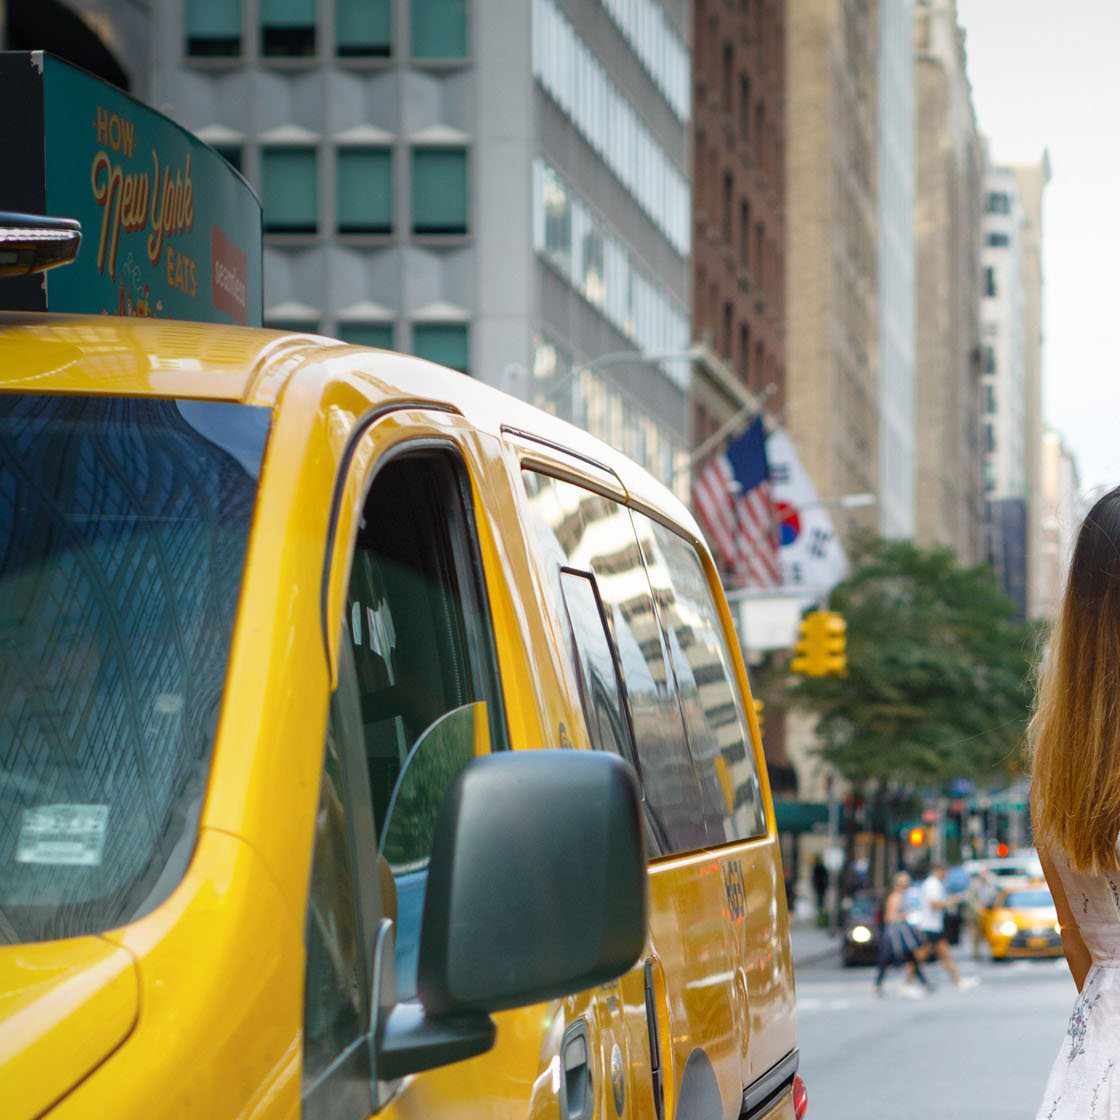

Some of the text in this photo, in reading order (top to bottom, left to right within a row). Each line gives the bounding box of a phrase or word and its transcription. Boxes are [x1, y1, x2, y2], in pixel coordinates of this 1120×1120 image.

[96, 105, 134, 159] HOW
[92, 150, 193, 283] New York
[166, 245, 198, 297] EATS
